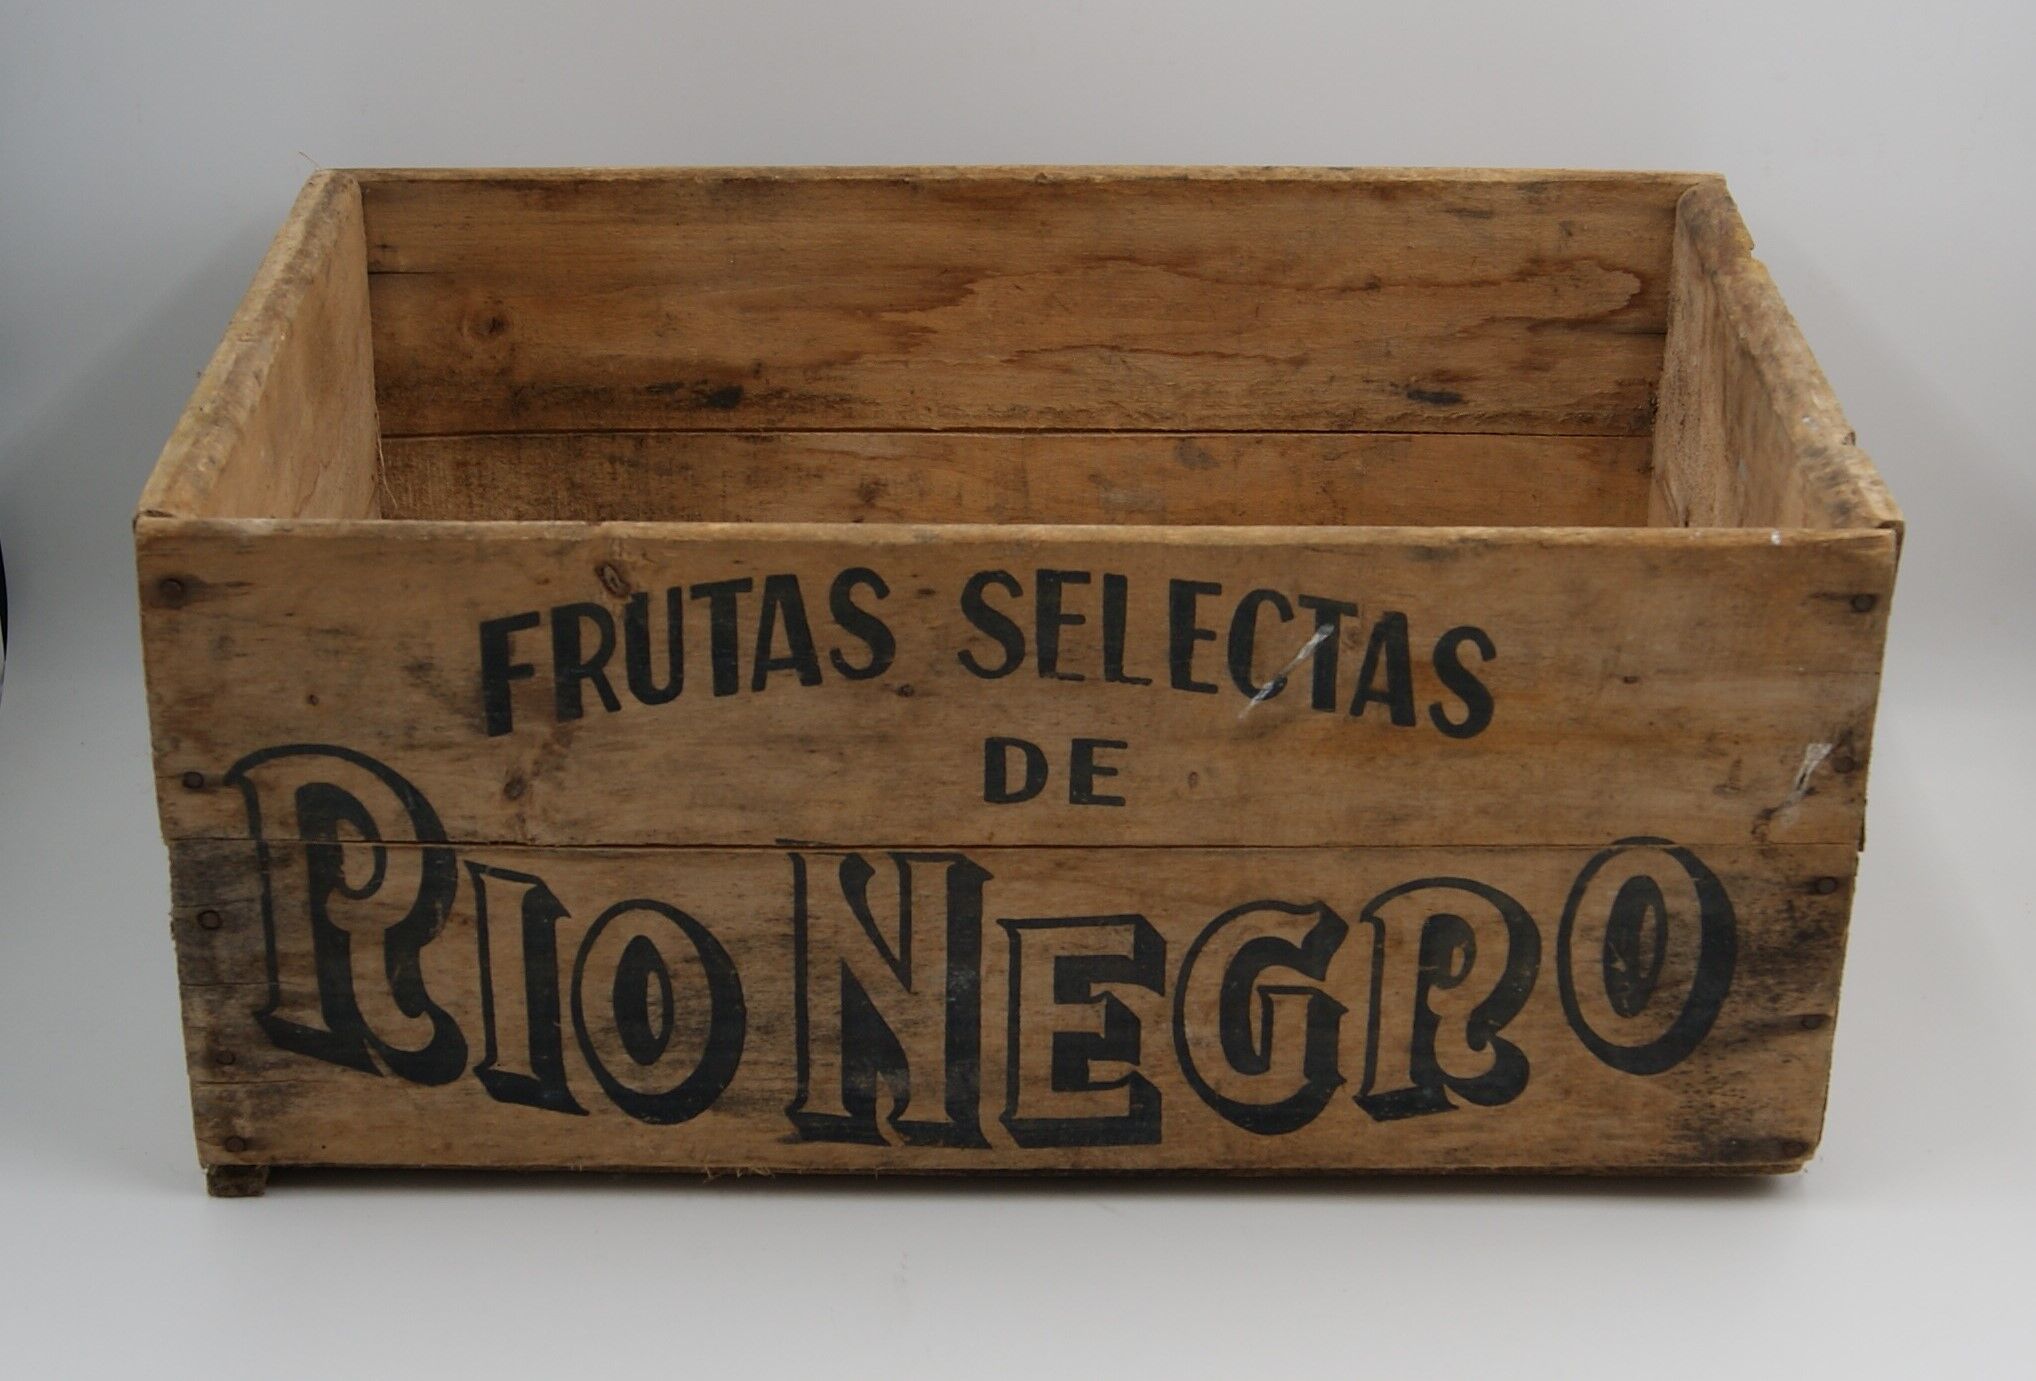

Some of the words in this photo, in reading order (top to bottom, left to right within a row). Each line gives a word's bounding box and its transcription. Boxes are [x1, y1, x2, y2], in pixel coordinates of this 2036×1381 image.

[481, 567, 895, 737] FRUTAS
[959, 567, 1497, 738] SELECTAS
[985, 738, 1126, 805] DE
[228, 745, 748, 1124] RIO
[780, 836, 1738, 1149] NEGRO
